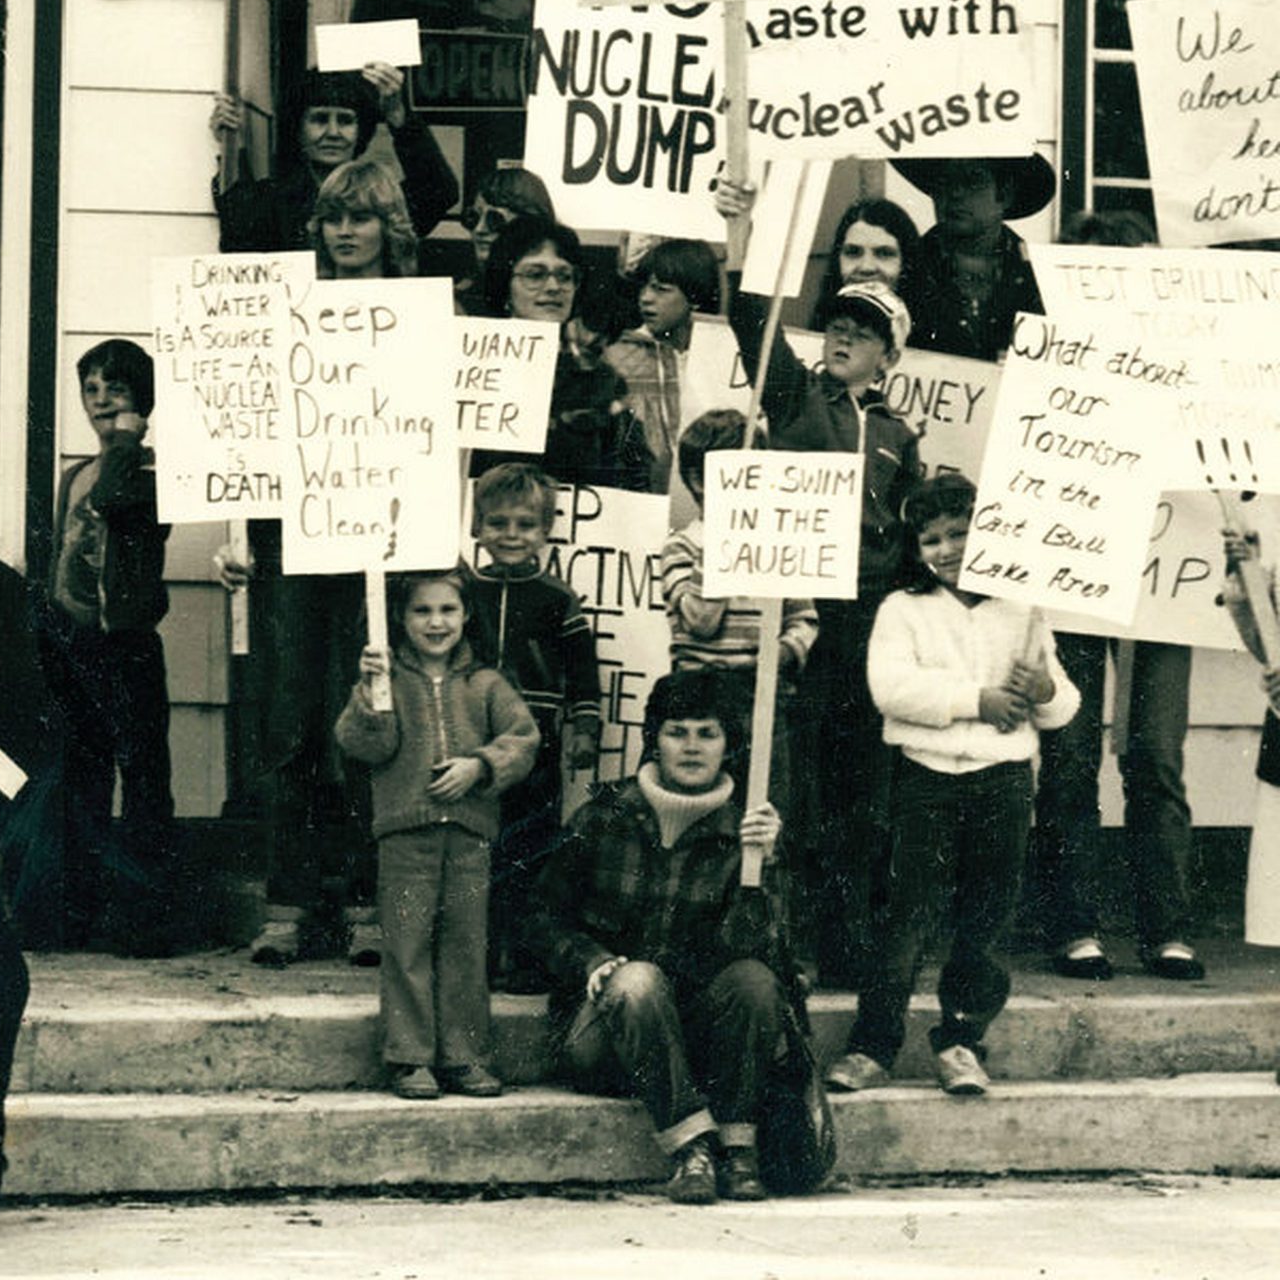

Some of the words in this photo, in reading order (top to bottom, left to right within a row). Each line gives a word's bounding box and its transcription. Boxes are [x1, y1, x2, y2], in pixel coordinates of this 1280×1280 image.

[747, 0, 866, 48] aste
[1177, 11, 1254, 63] We
[418, 43, 517, 100] OPEN
[529, 27, 715, 108] NUCLE
[1179, 71, 1280, 113] about
[748, 82, 884, 139] uclear
[877, 82, 1020, 152] waste
[1193, 175, 1280, 220] don't
[192, 260, 282, 288] DRINKING
[1055, 263, 1130, 301] TEST
[202, 295, 270, 318] WATER
[286, 282, 397, 347] Keep
[182, 328, 197, 351] A
[205, 325, 274, 350] SOURCE
[463, 332, 544, 362] WANT
[1012, 317, 1099, 369] What
[1107, 346, 1197, 389] about
[289, 342, 366, 385] Our
[194, 381, 279, 410] NUCLEA
[883, 373, 986, 424] ONEY
[1049, 386, 1110, 416] our
[204, 409, 278, 440] WASTE
[294, 387, 434, 455] Drinking
[456, 400, 519, 437] TER
[1020, 414, 1141, 469] Tourism
[297, 441, 402, 488] Water
[720, 466, 761, 490] WE
[785, 465, 855, 497] SWIM
[207, 473, 282, 503] DEATH
[1009, 470, 1045, 499] in
[1060, 483, 1101, 510] the
[730, 509, 758, 531] IN
[775, 509, 828, 533] THE
[975, 502, 1027, 537] East
[1042, 523, 1105, 554] Bull
[718, 544, 839, 579] SAUBLE
[966, 549, 1028, 583] Lake
[1048, 567, 1109, 598] Area
